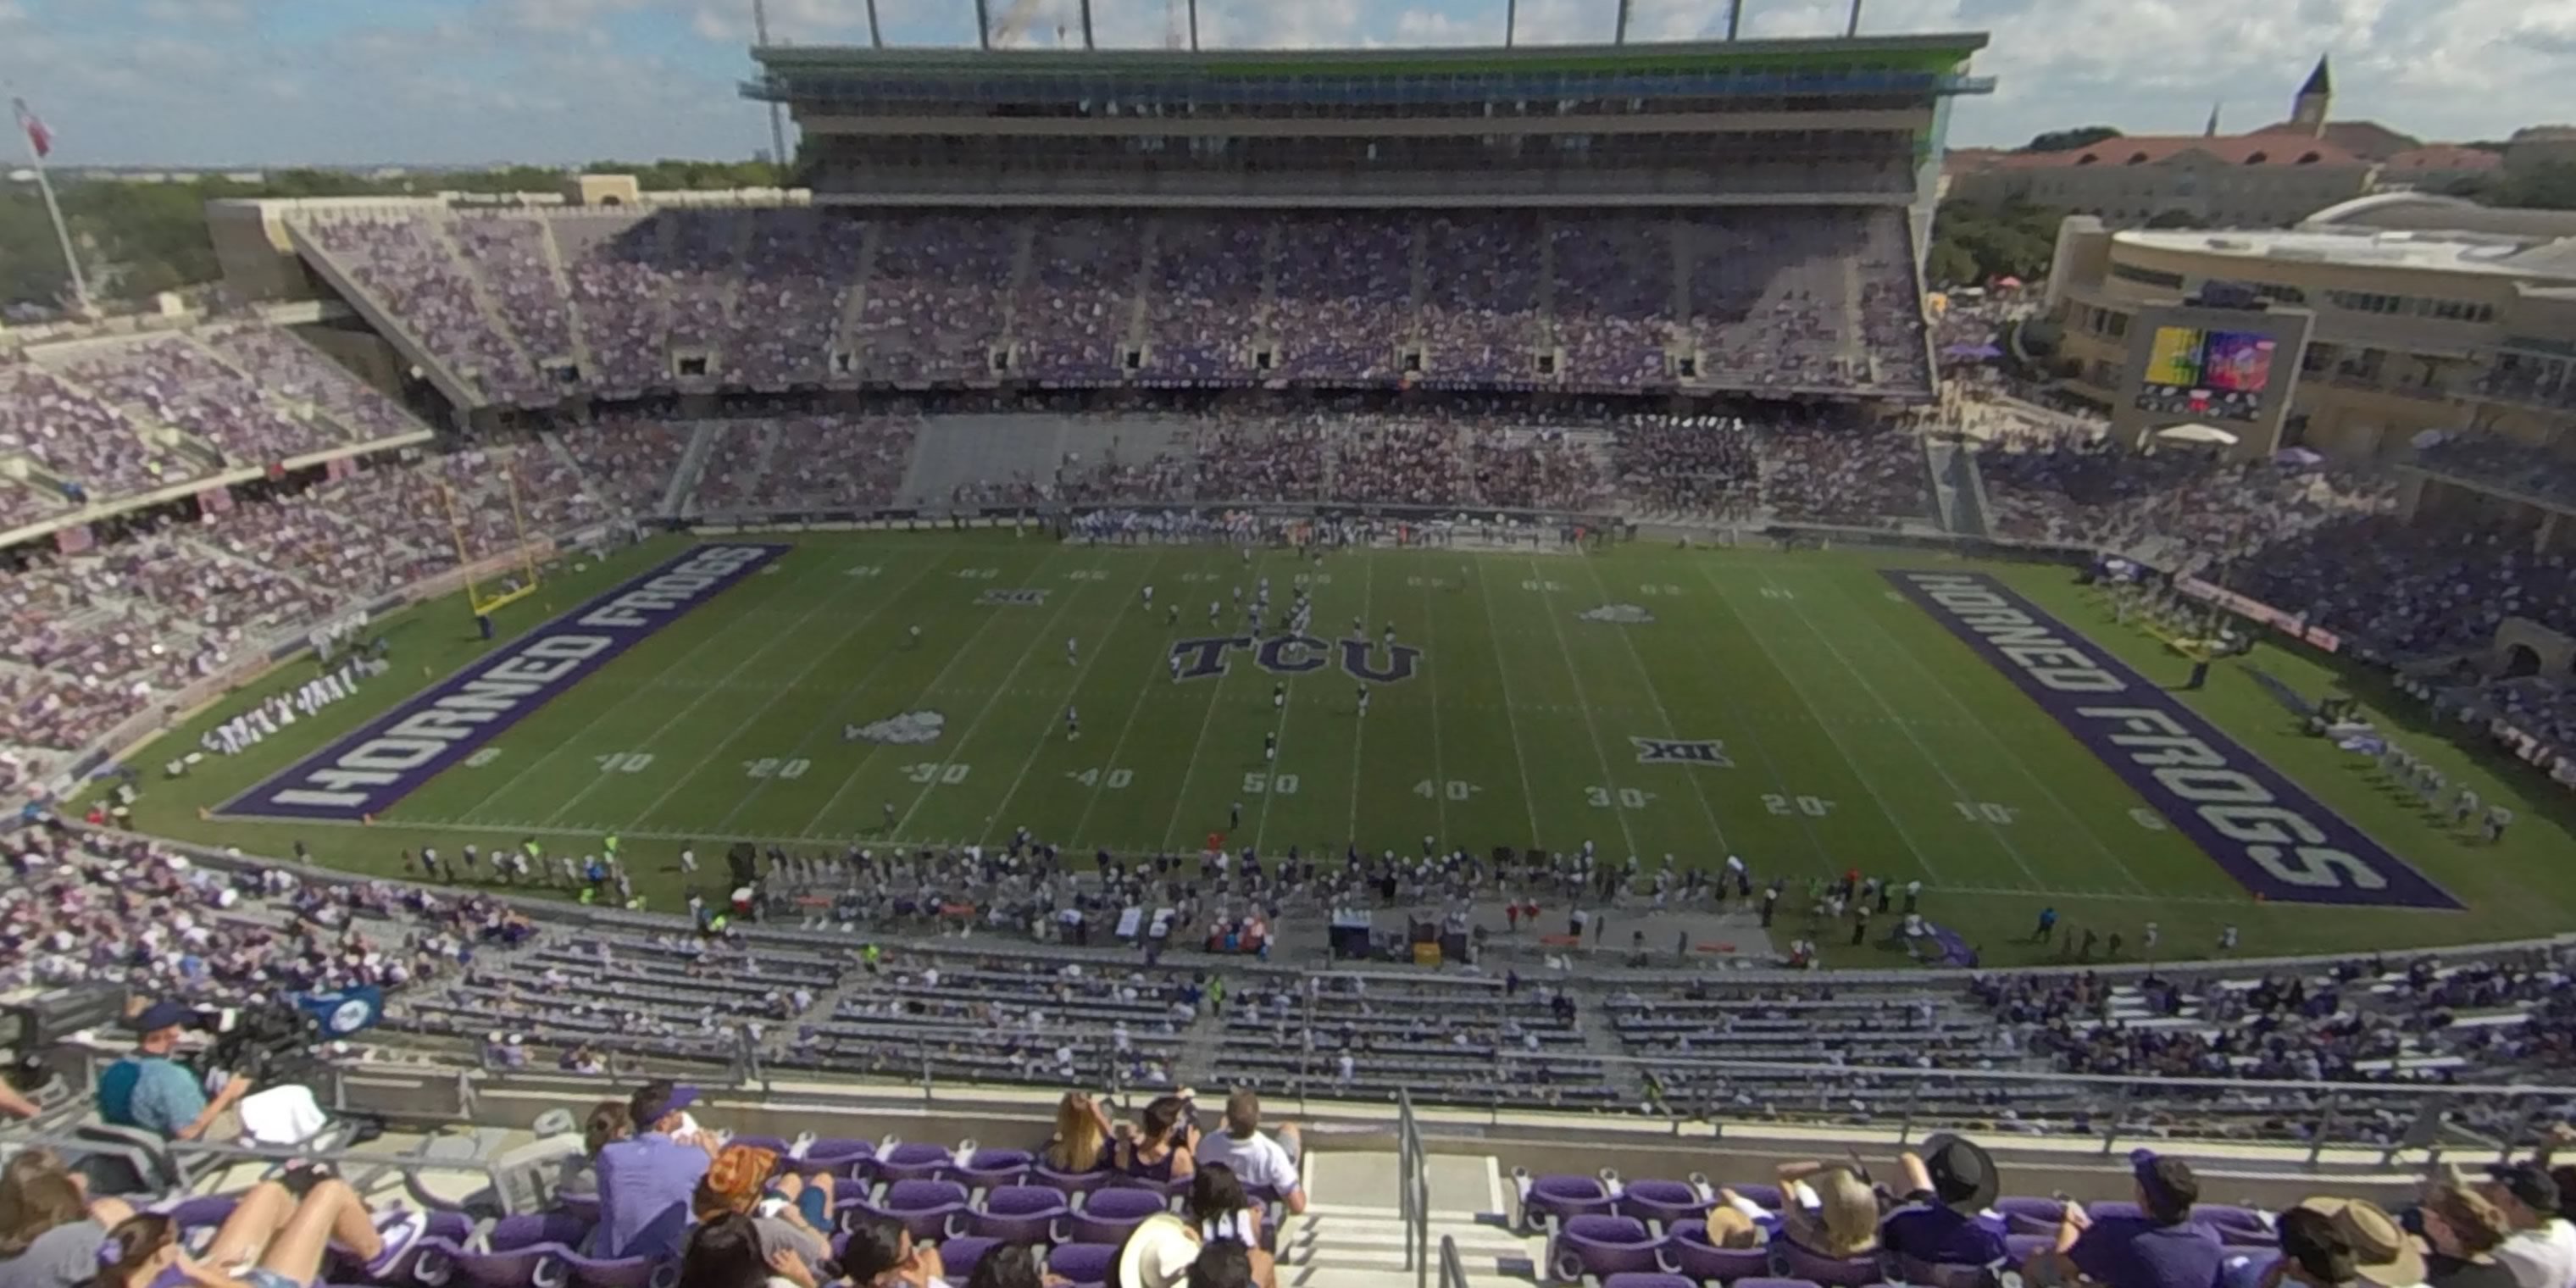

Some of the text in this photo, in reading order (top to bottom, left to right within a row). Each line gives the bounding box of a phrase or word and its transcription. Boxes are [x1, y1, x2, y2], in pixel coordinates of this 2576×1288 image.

[1169, 636, 1424, 684] TCU
[271, 546, 764, 807] HORNED FROGS
[1906, 574, 2128, 691] HORNED
[2076, 707, 2387, 889] FROGS
[909, 763, 971, 785] 30
[1076, 768, 1133, 789] 40
[1242, 772, 1299, 794] 50
[1413, 780, 1469, 800] 40
[1585, 786, 1646, 808] 30
[1761, 793, 1826, 816] 20
[1953, 802, 2012, 824] 10
